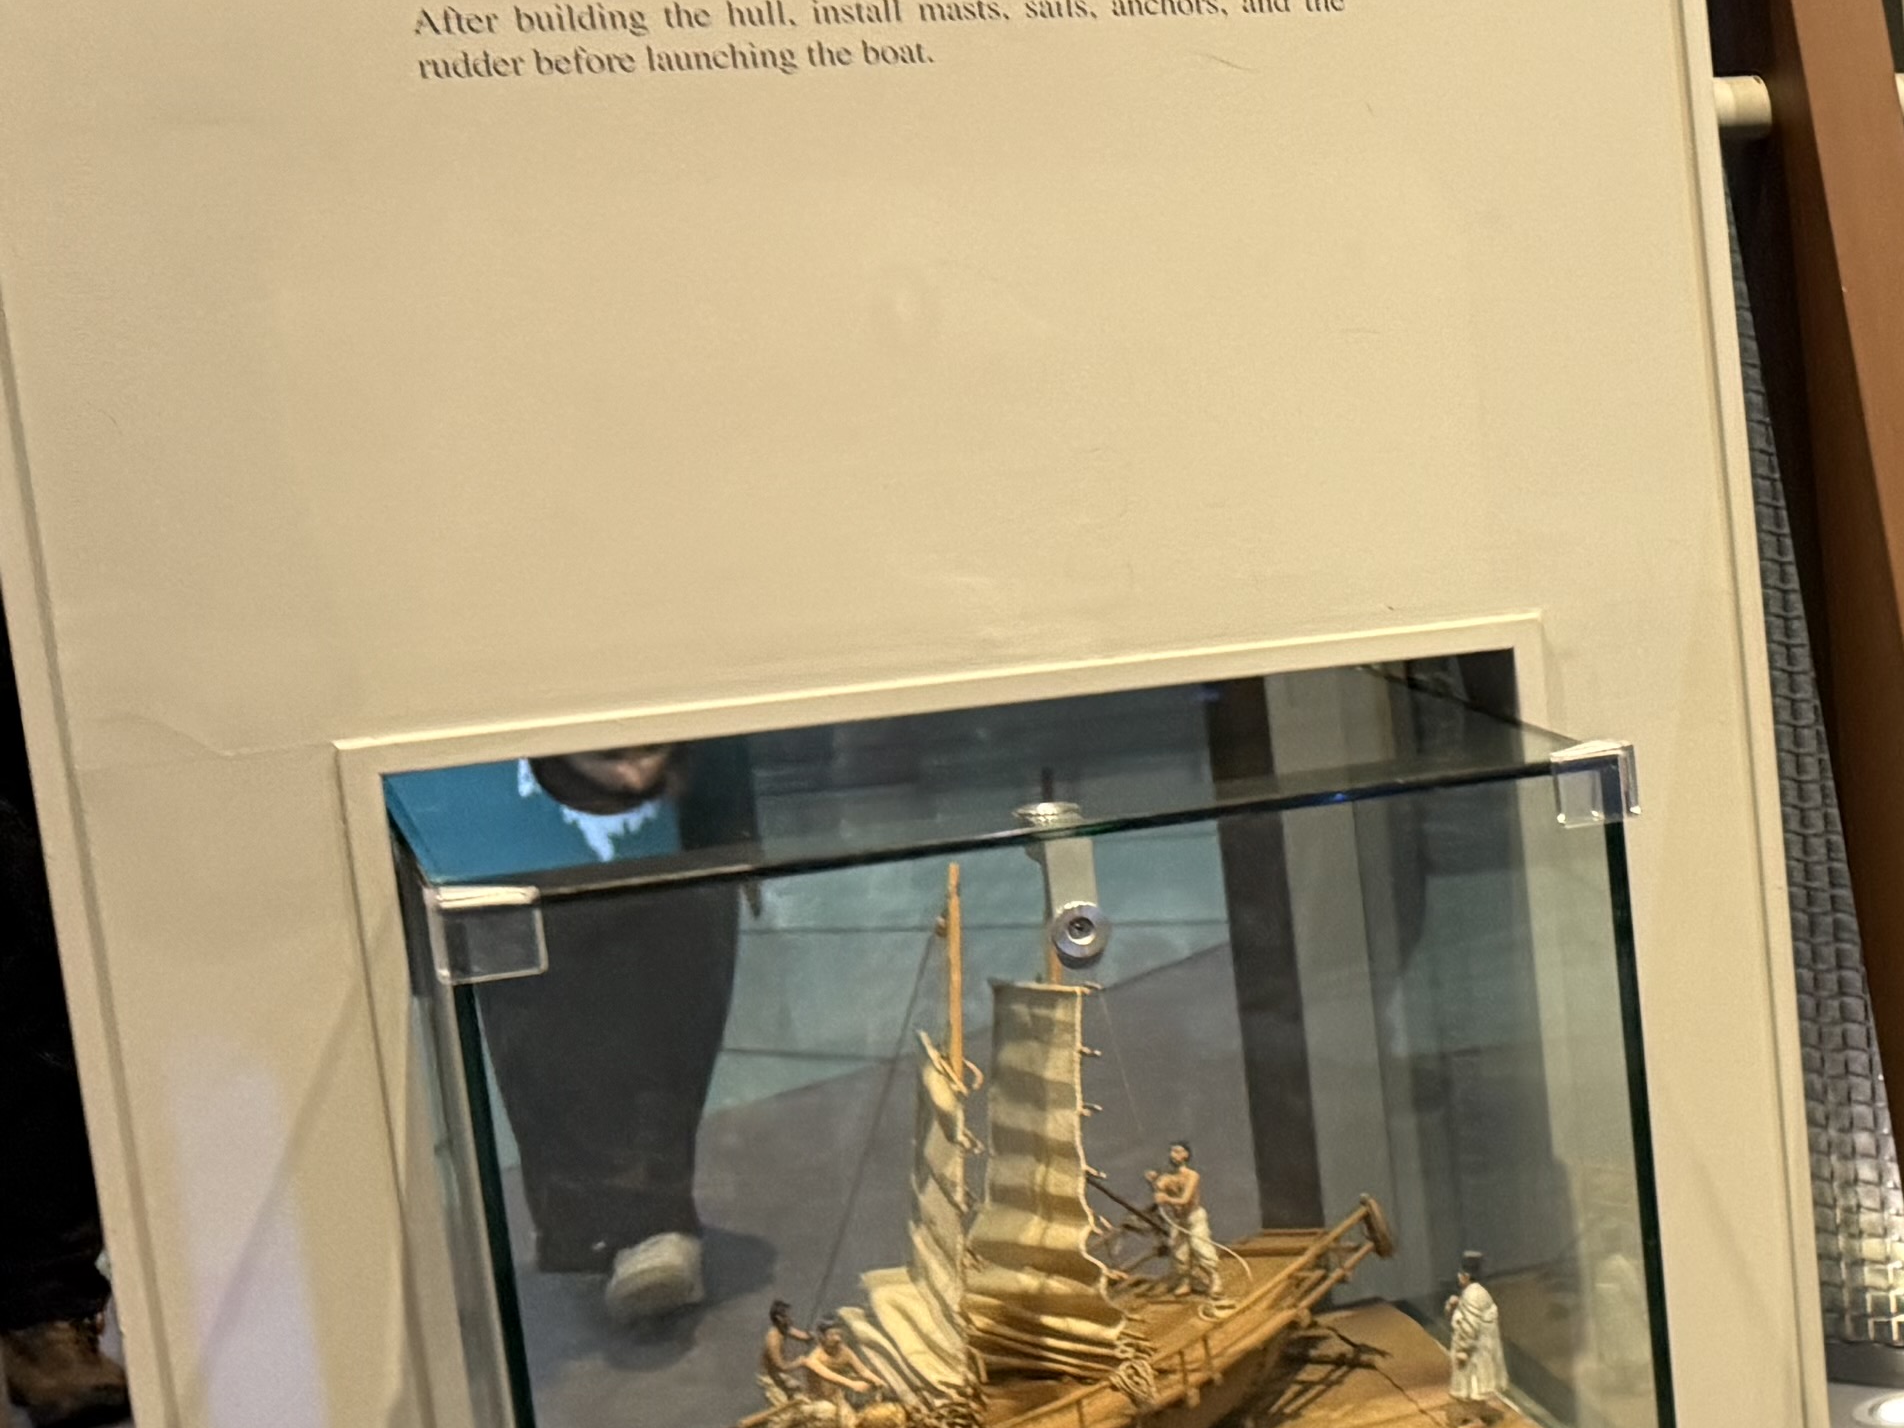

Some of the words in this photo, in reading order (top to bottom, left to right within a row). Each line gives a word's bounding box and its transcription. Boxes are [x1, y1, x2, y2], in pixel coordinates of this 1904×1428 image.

[413, 5, 499, 36] After
[513, 1, 650, 38] building
[663, 1, 712, 30] the
[417, 49, 526, 80] rudder
[531, 45, 636, 76] before
[645, 41, 799, 76] launching
[806, 39, 853, 68] the
[860, 38, 935, 66] boat.
